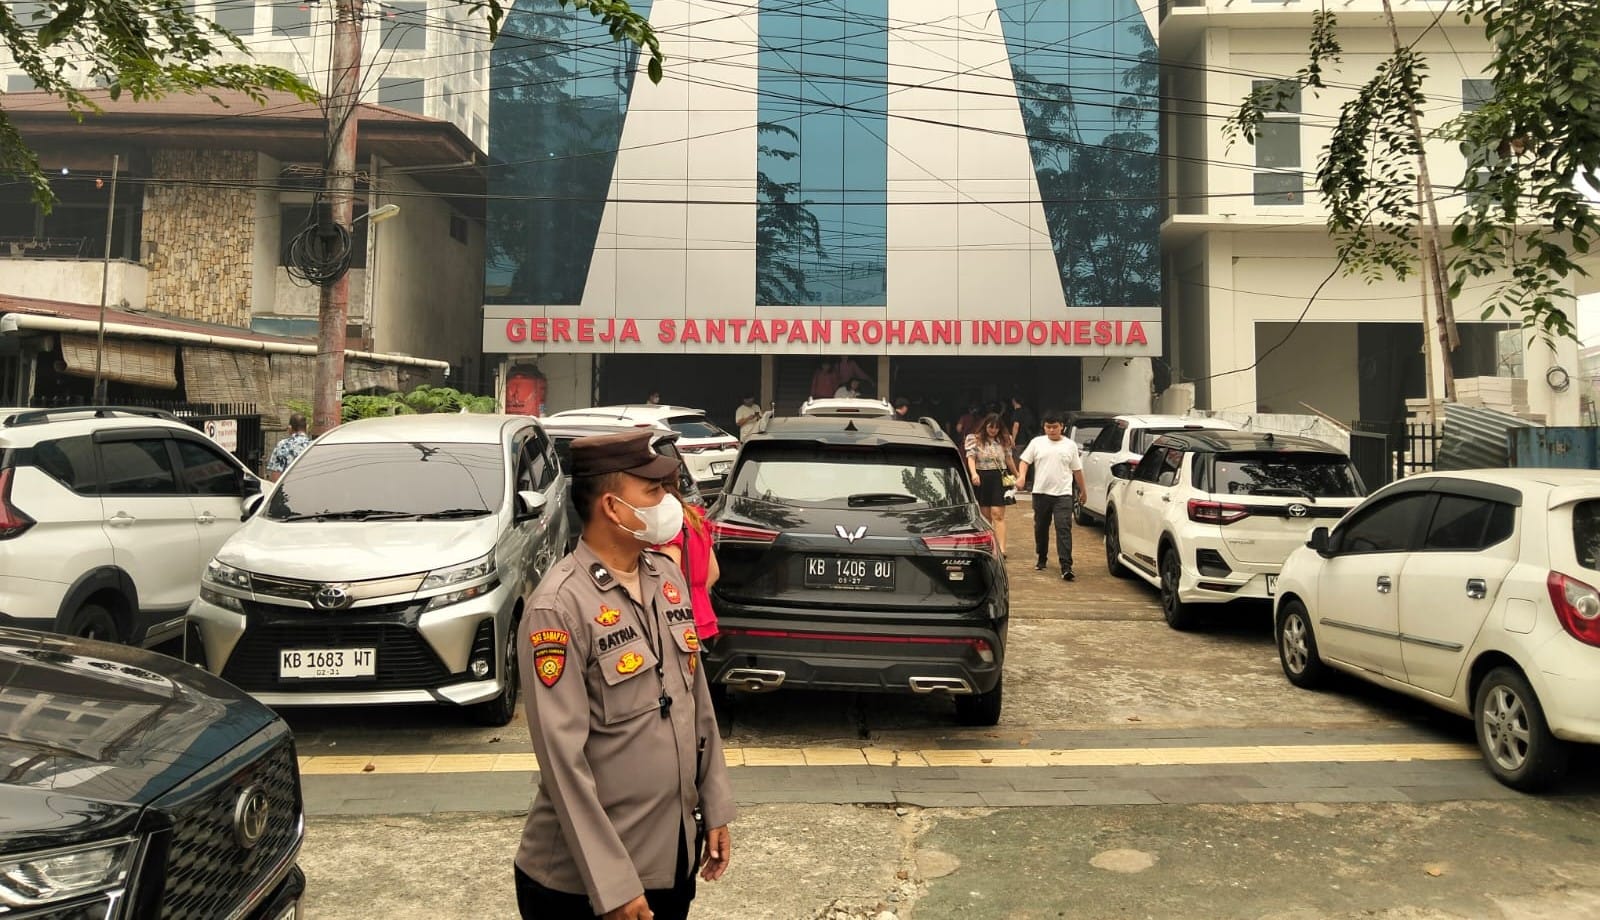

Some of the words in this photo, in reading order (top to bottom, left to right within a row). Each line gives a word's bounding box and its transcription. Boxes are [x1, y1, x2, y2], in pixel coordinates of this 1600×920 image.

[506, 317, 640, 342] GEREJA
[658, 319, 831, 344] SANTAPAN
[841, 320, 961, 344] ROHANI
[972, 320, 1147, 345] INDONESIA
[809, 558, 825, 575] KB
[837, 560, 866, 577] 1406
[599, 625, 638, 651] SATRIA
[283, 653, 302, 669] KB
[307, 652, 344, 668] 1683
[354, 651, 372, 666] WT
